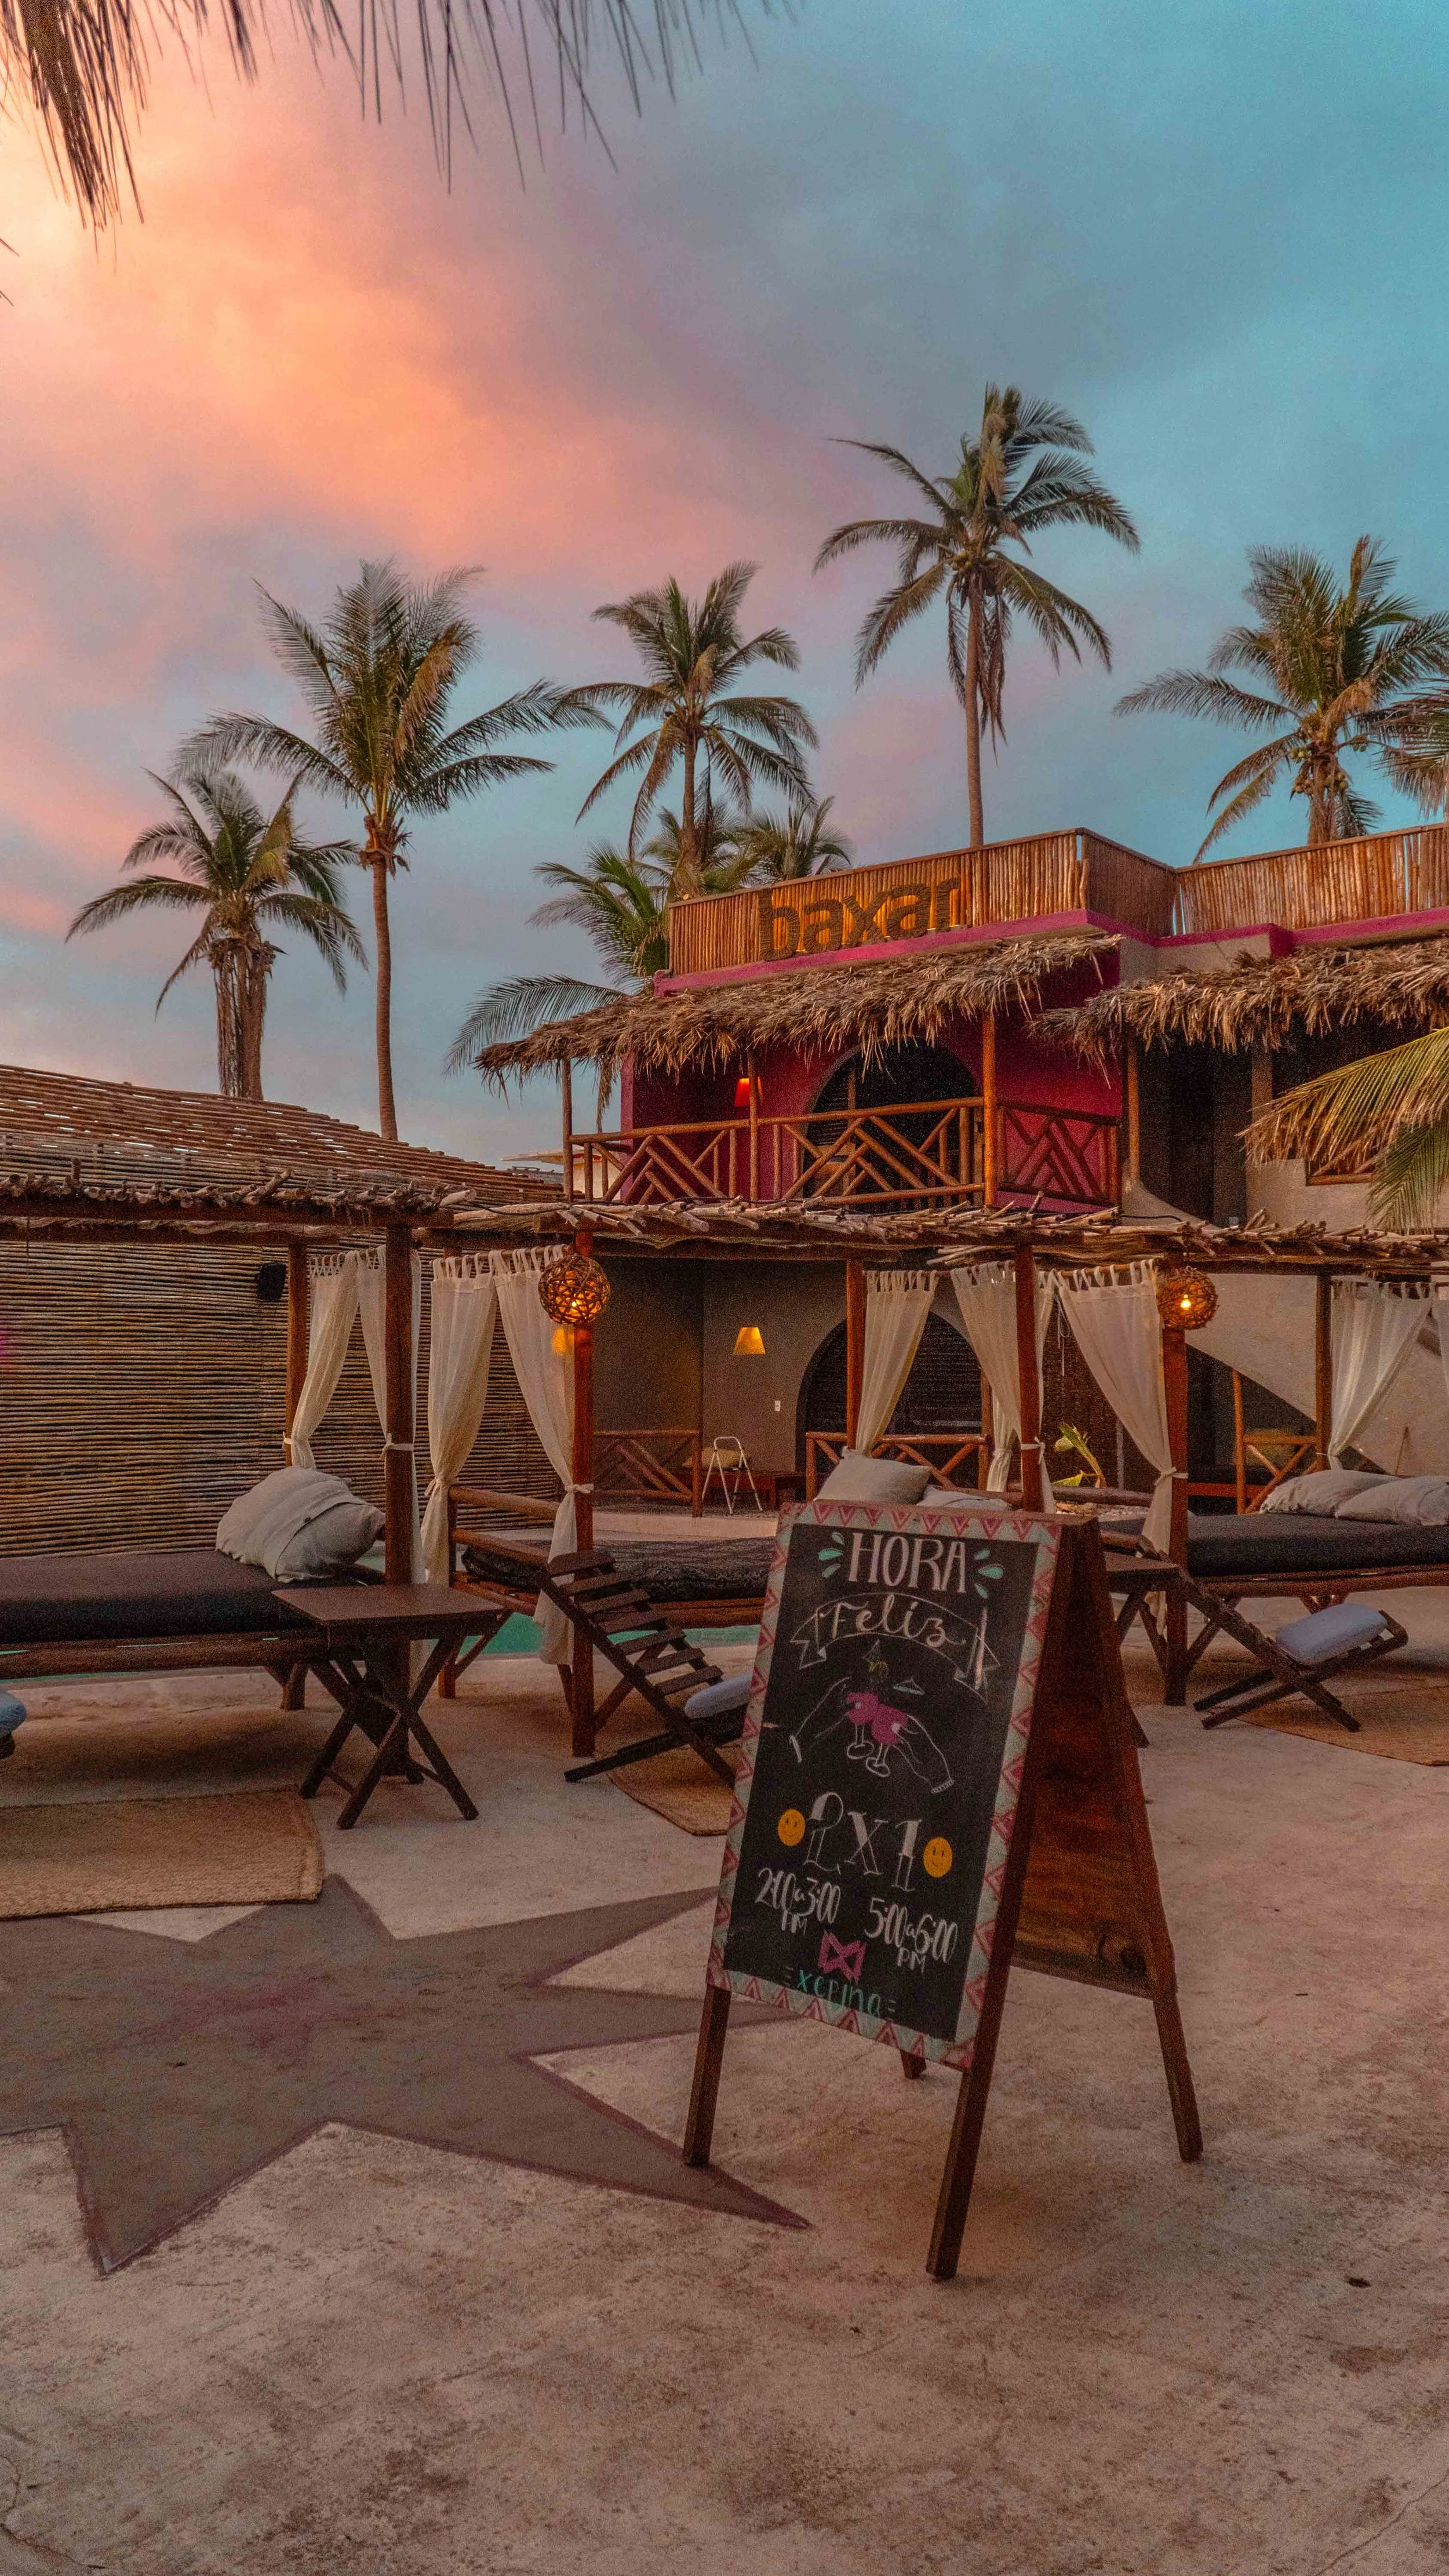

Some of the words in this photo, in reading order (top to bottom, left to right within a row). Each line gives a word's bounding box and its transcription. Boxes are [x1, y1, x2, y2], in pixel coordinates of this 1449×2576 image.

[759, 877, 961, 962] baxar
[847, 1531, 967, 1593] HORA
[818, 1593, 967, 1647] Feliz
[897, 1946, 927, 1974] PM
